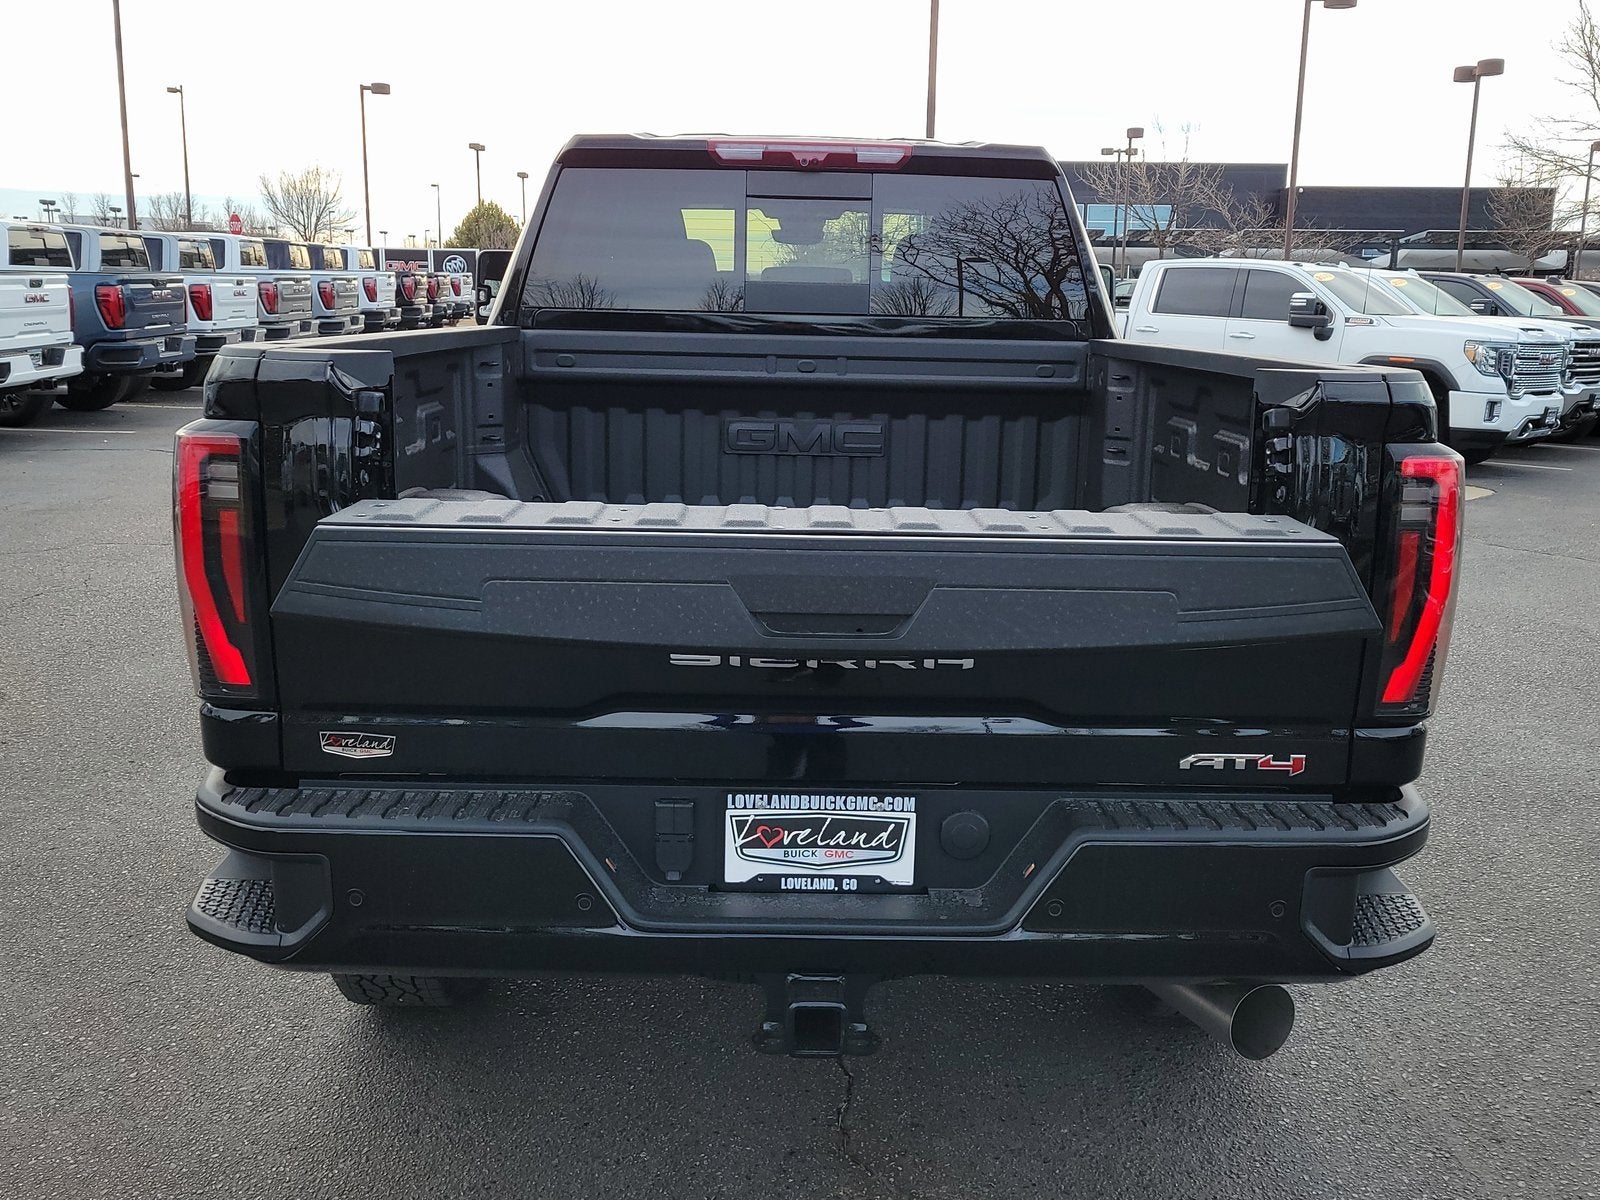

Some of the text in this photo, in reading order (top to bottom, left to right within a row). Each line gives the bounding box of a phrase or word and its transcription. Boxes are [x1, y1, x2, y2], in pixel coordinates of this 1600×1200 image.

[230, 221, 241, 232] STOP
[385, 260, 429, 272] GMC
[24, 292, 50, 304] GMC
[727, 422, 883, 454] GMC
[1179, 753, 1307, 777] AT4
[727, 794, 916, 812] LOVELANDBUICKGMC.COM
[735, 814, 898, 849] Loveland
[783, 849, 855, 859] BUICK GMC
[780, 877, 858, 891] LOVELAND, CO
